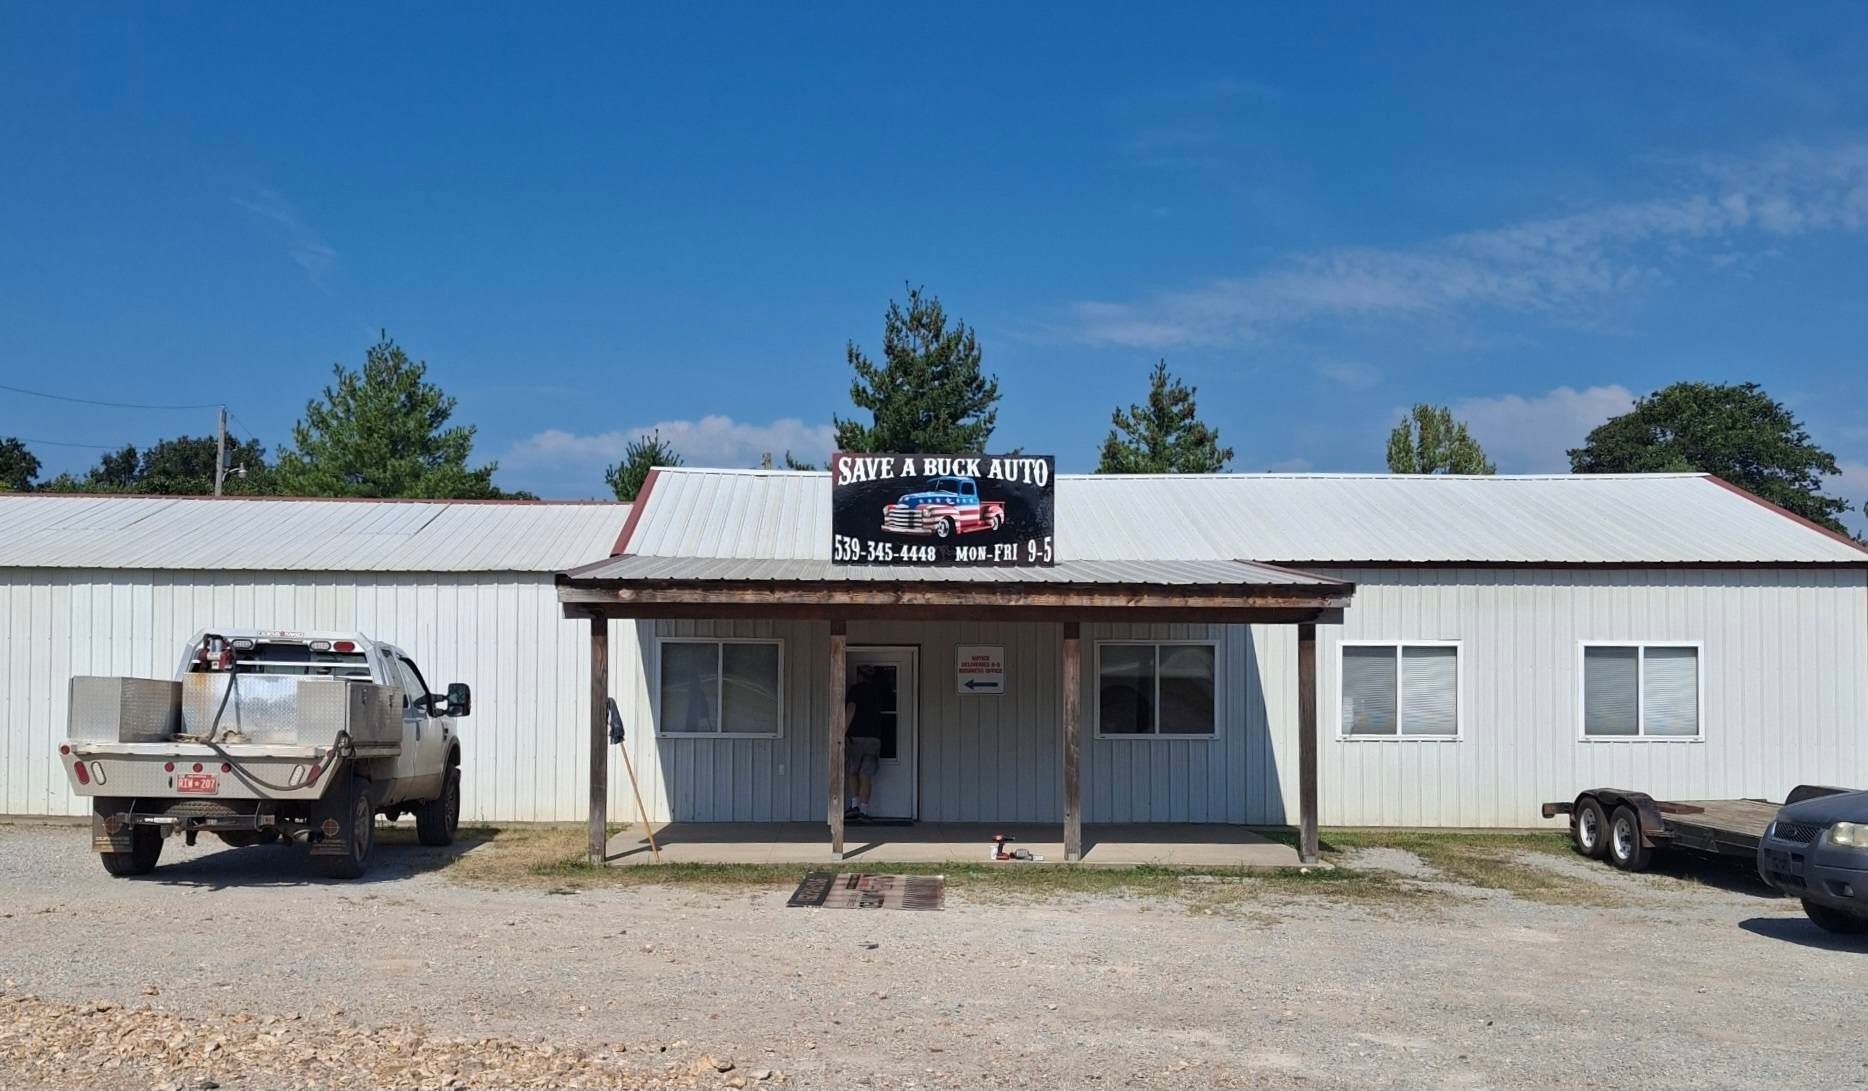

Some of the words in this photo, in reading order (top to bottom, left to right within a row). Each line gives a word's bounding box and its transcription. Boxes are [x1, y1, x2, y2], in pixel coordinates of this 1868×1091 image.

[837, 456, 894, 486] SAVE
[900, 457, 917, 477] A
[923, 457, 982, 478] BUCK
[987, 458, 1049, 488] AUTO
[834, 534, 936, 562] 539-345-4448
[955, 543, 1018, 562] MON-FRI
[1028, 536, 1052, 563] 9-5
